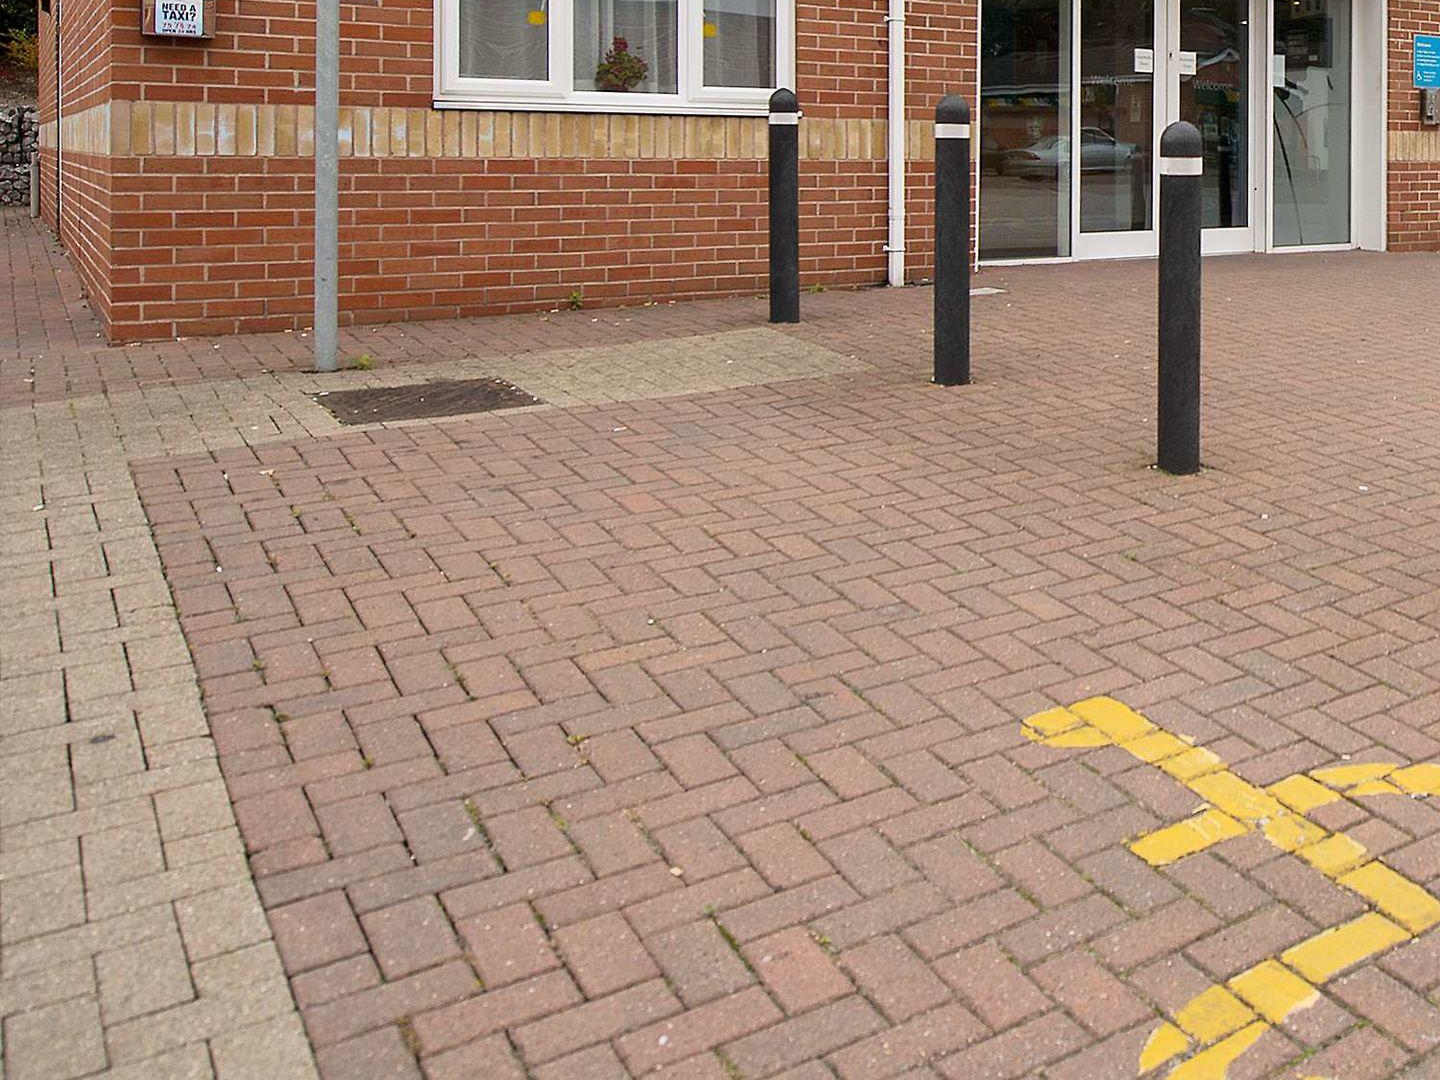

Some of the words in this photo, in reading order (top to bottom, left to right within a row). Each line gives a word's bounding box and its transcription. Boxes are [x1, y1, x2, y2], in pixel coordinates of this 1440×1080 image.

[162, 3, 187, 11] NEED
[190, 4, 196, 12] A
[162, 10, 196, 21] TAXI?
